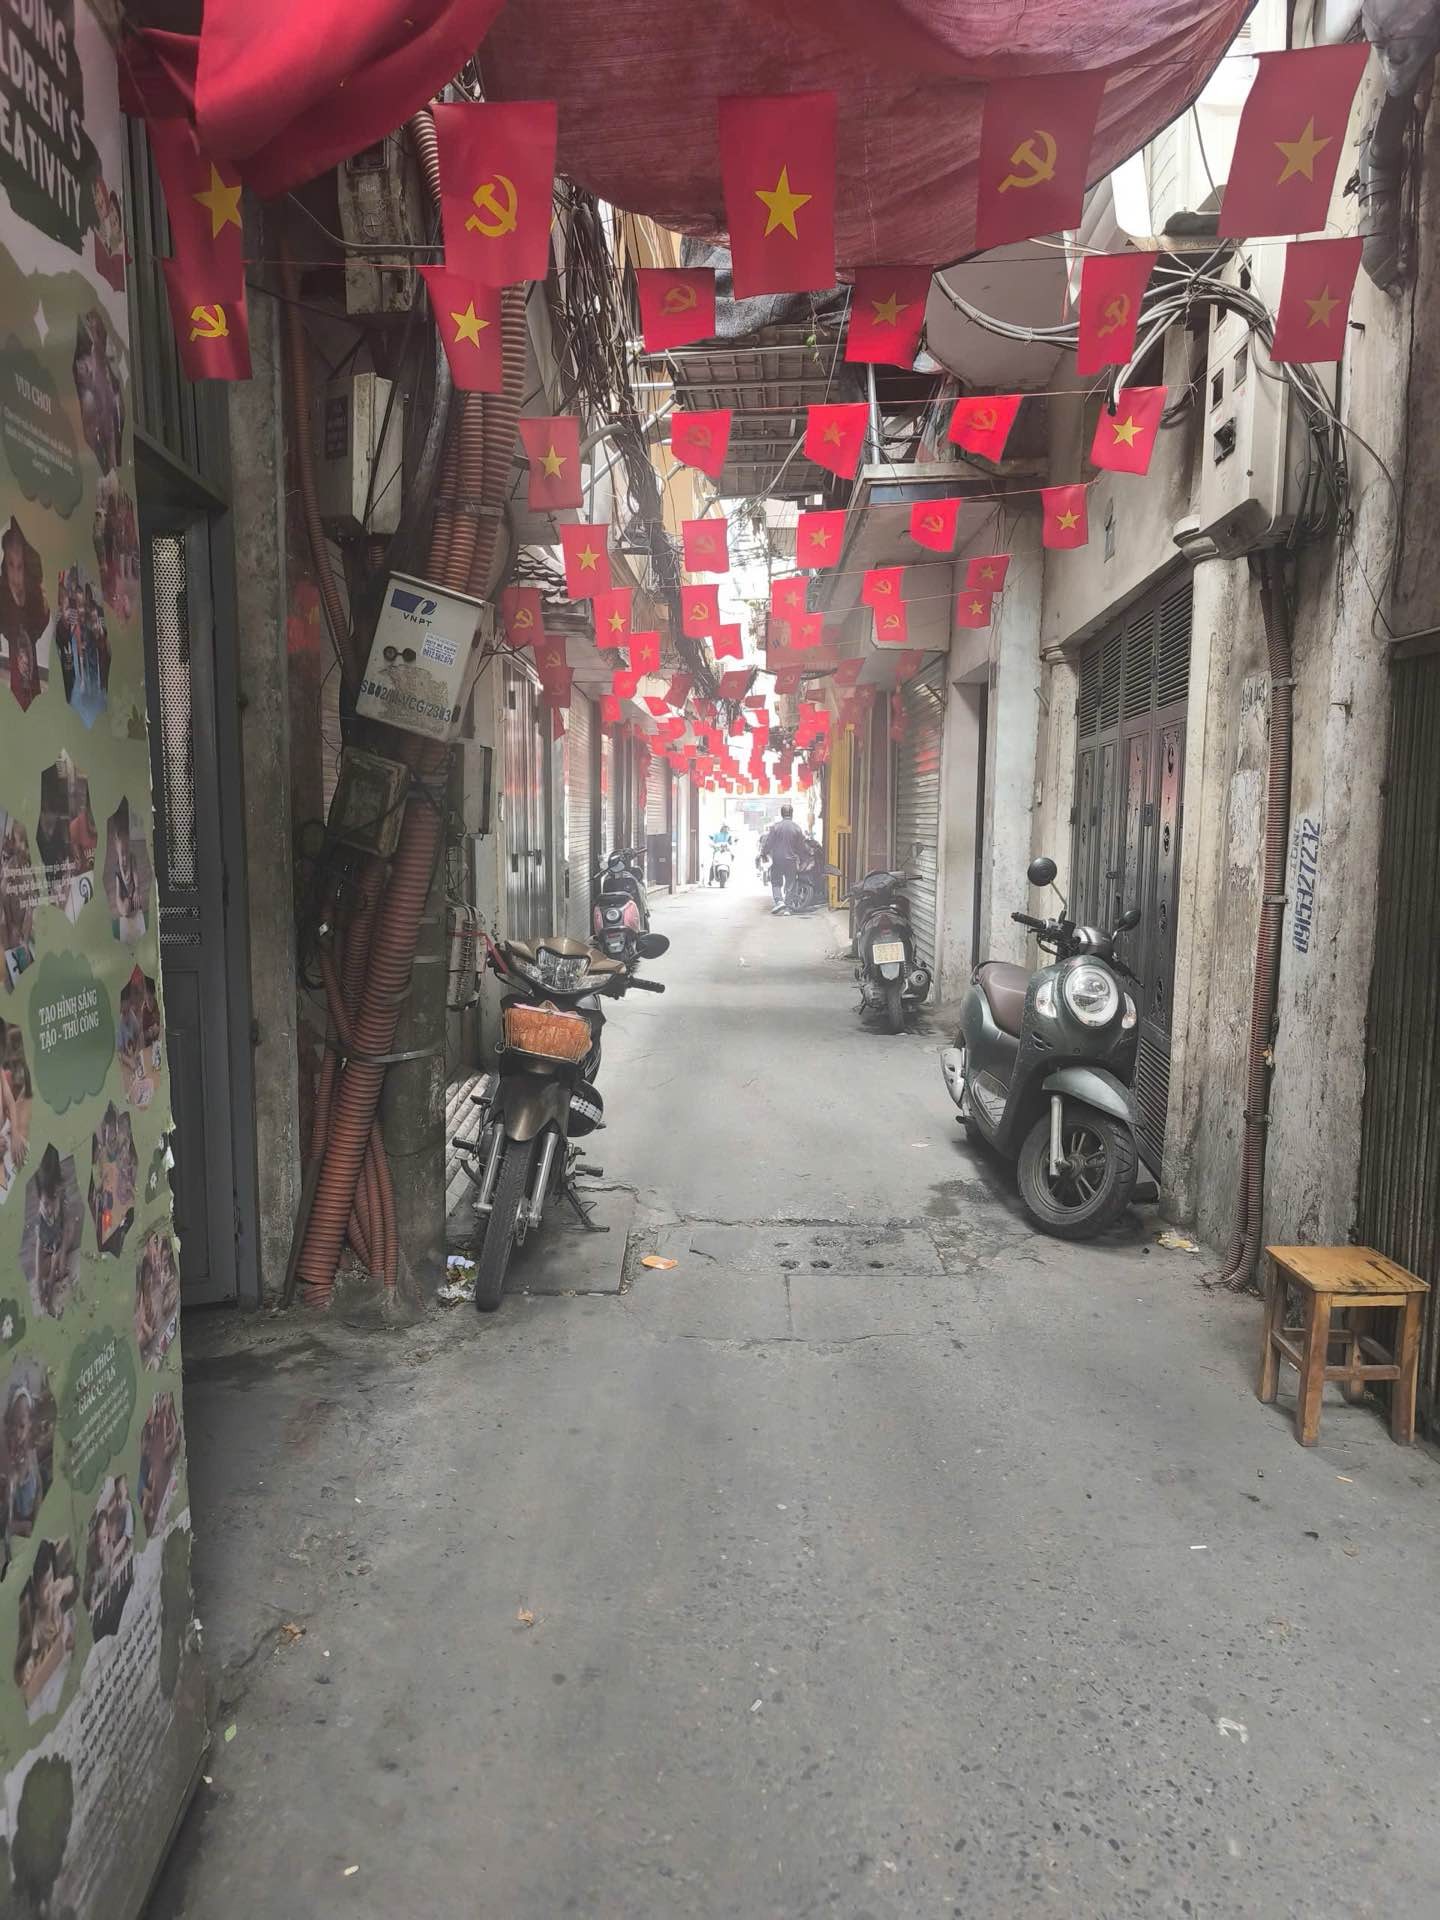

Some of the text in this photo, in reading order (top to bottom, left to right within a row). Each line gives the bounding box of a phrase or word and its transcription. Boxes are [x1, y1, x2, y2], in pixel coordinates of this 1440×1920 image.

[403, 612, 433, 627] VNPT
[1292, 818, 1321, 954] 0915327232
[39, 986, 97, 1029] TẠO HÌNH SÁNG
[40, 1028, 57, 1053] TẠO
[80, 1010, 99, 1033] CÔNG
